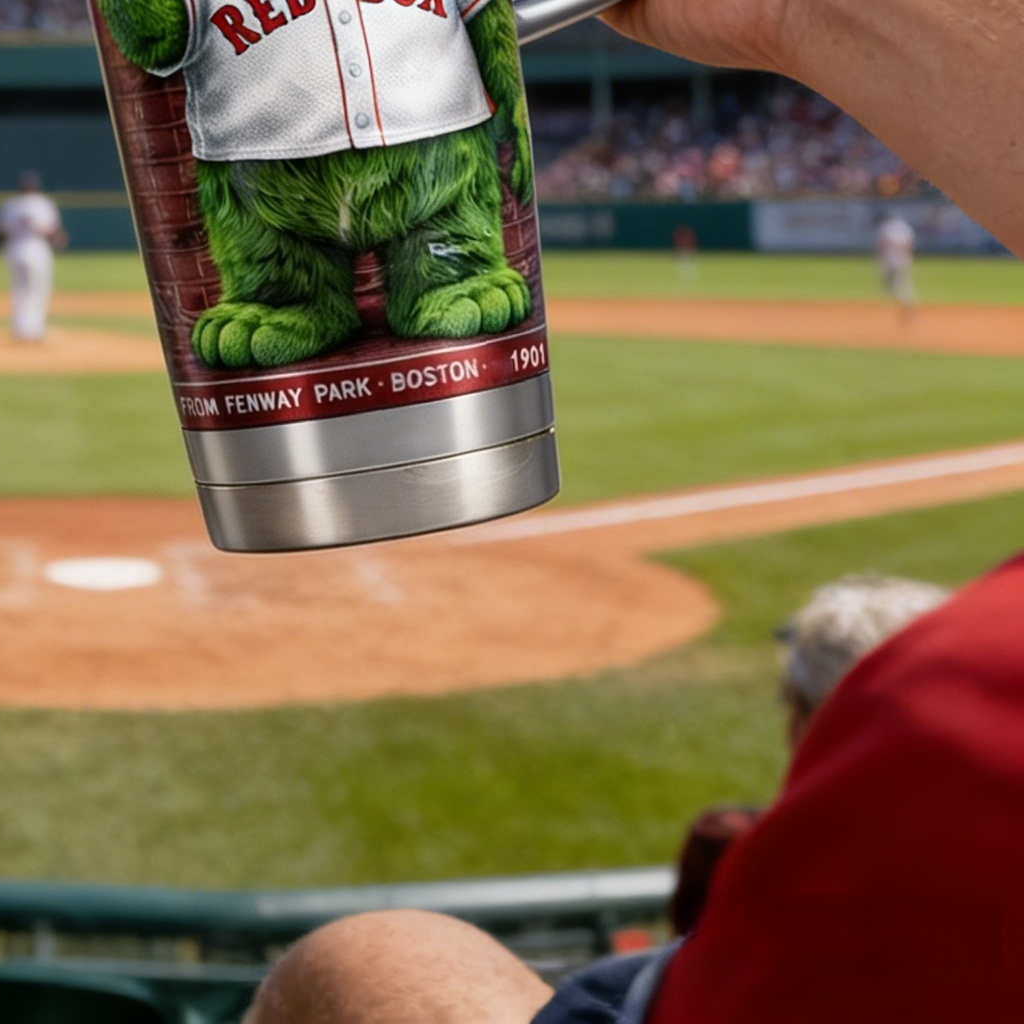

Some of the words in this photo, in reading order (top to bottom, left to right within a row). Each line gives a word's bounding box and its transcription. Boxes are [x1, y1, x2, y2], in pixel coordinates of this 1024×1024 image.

[180, 395, 220, 417] FROM
[224, 387, 302, 415] FENWAY
[314, 376, 372, 404] PARK
[510, 342, 545, 372] 1901
